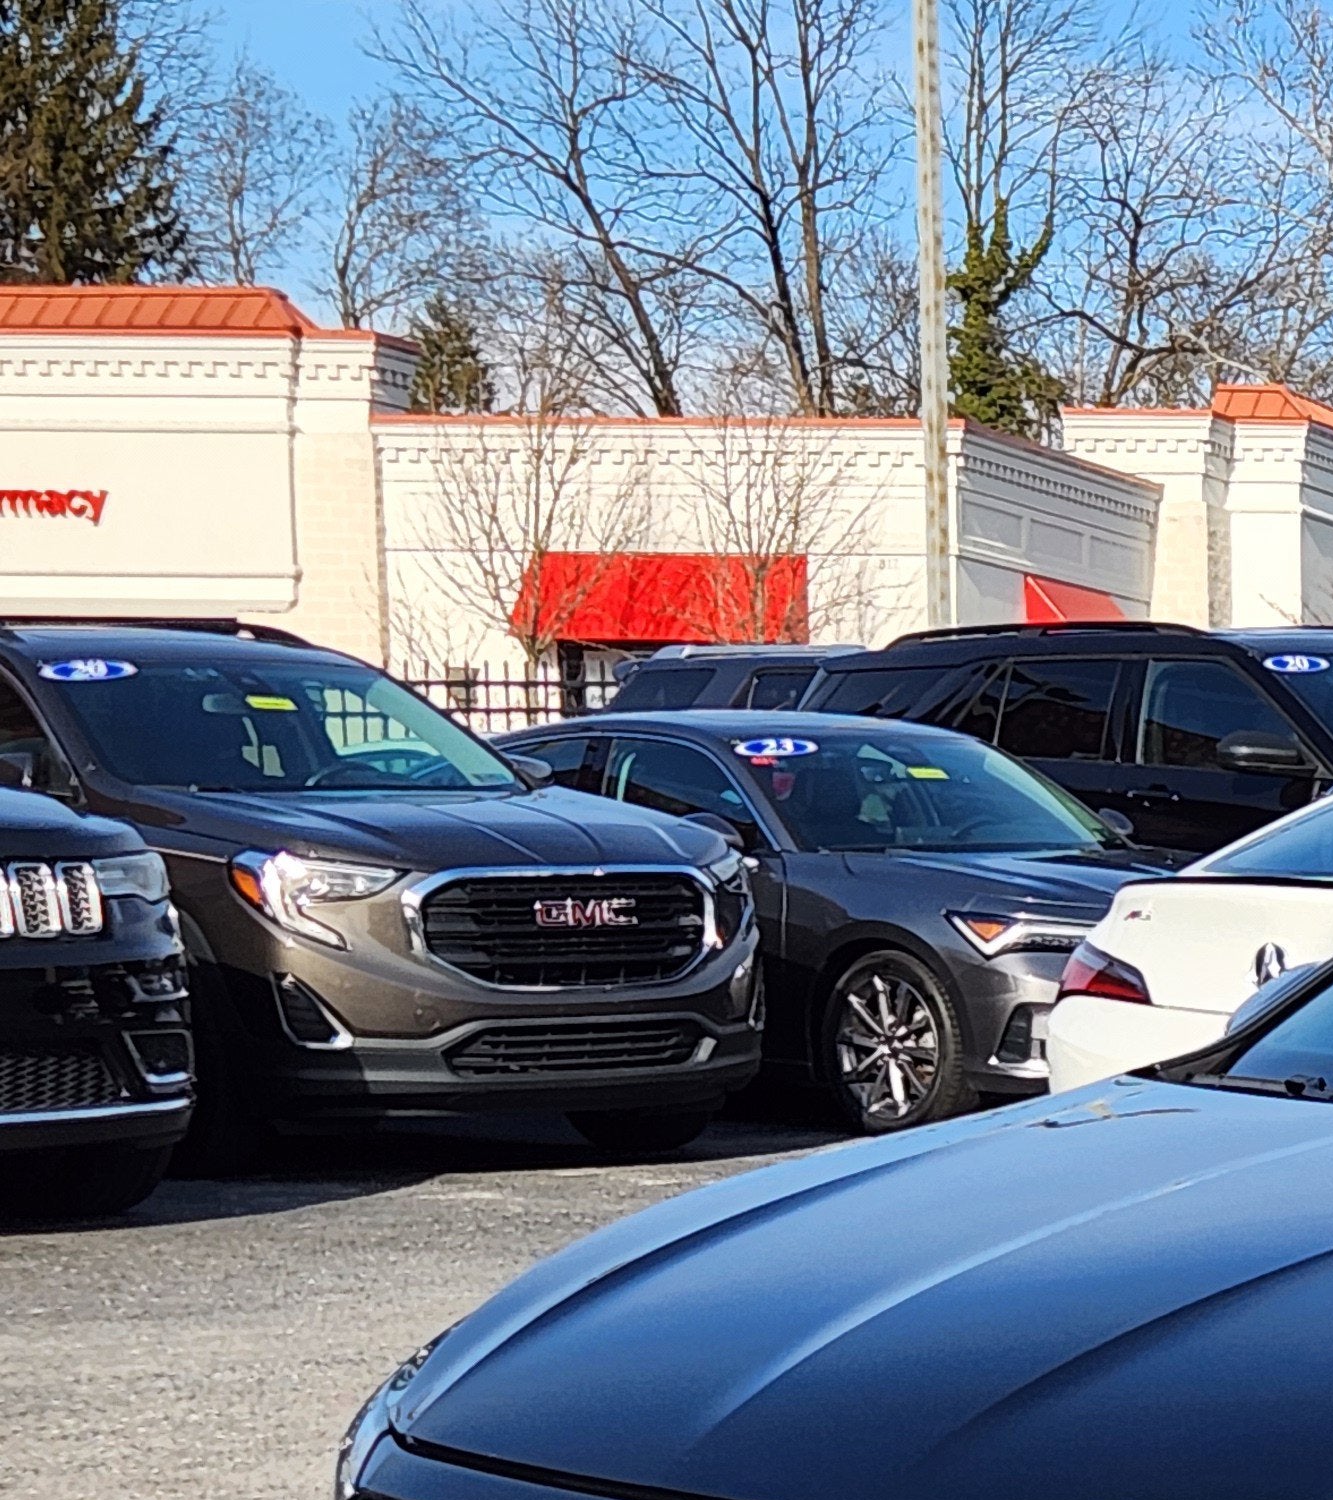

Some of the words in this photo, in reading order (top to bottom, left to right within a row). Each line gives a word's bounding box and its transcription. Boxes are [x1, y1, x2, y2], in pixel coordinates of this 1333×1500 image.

[1282, 655, 1310, 672] 20
[762, 738, 795, 755] 23
[533, 898, 638, 926] GMC
